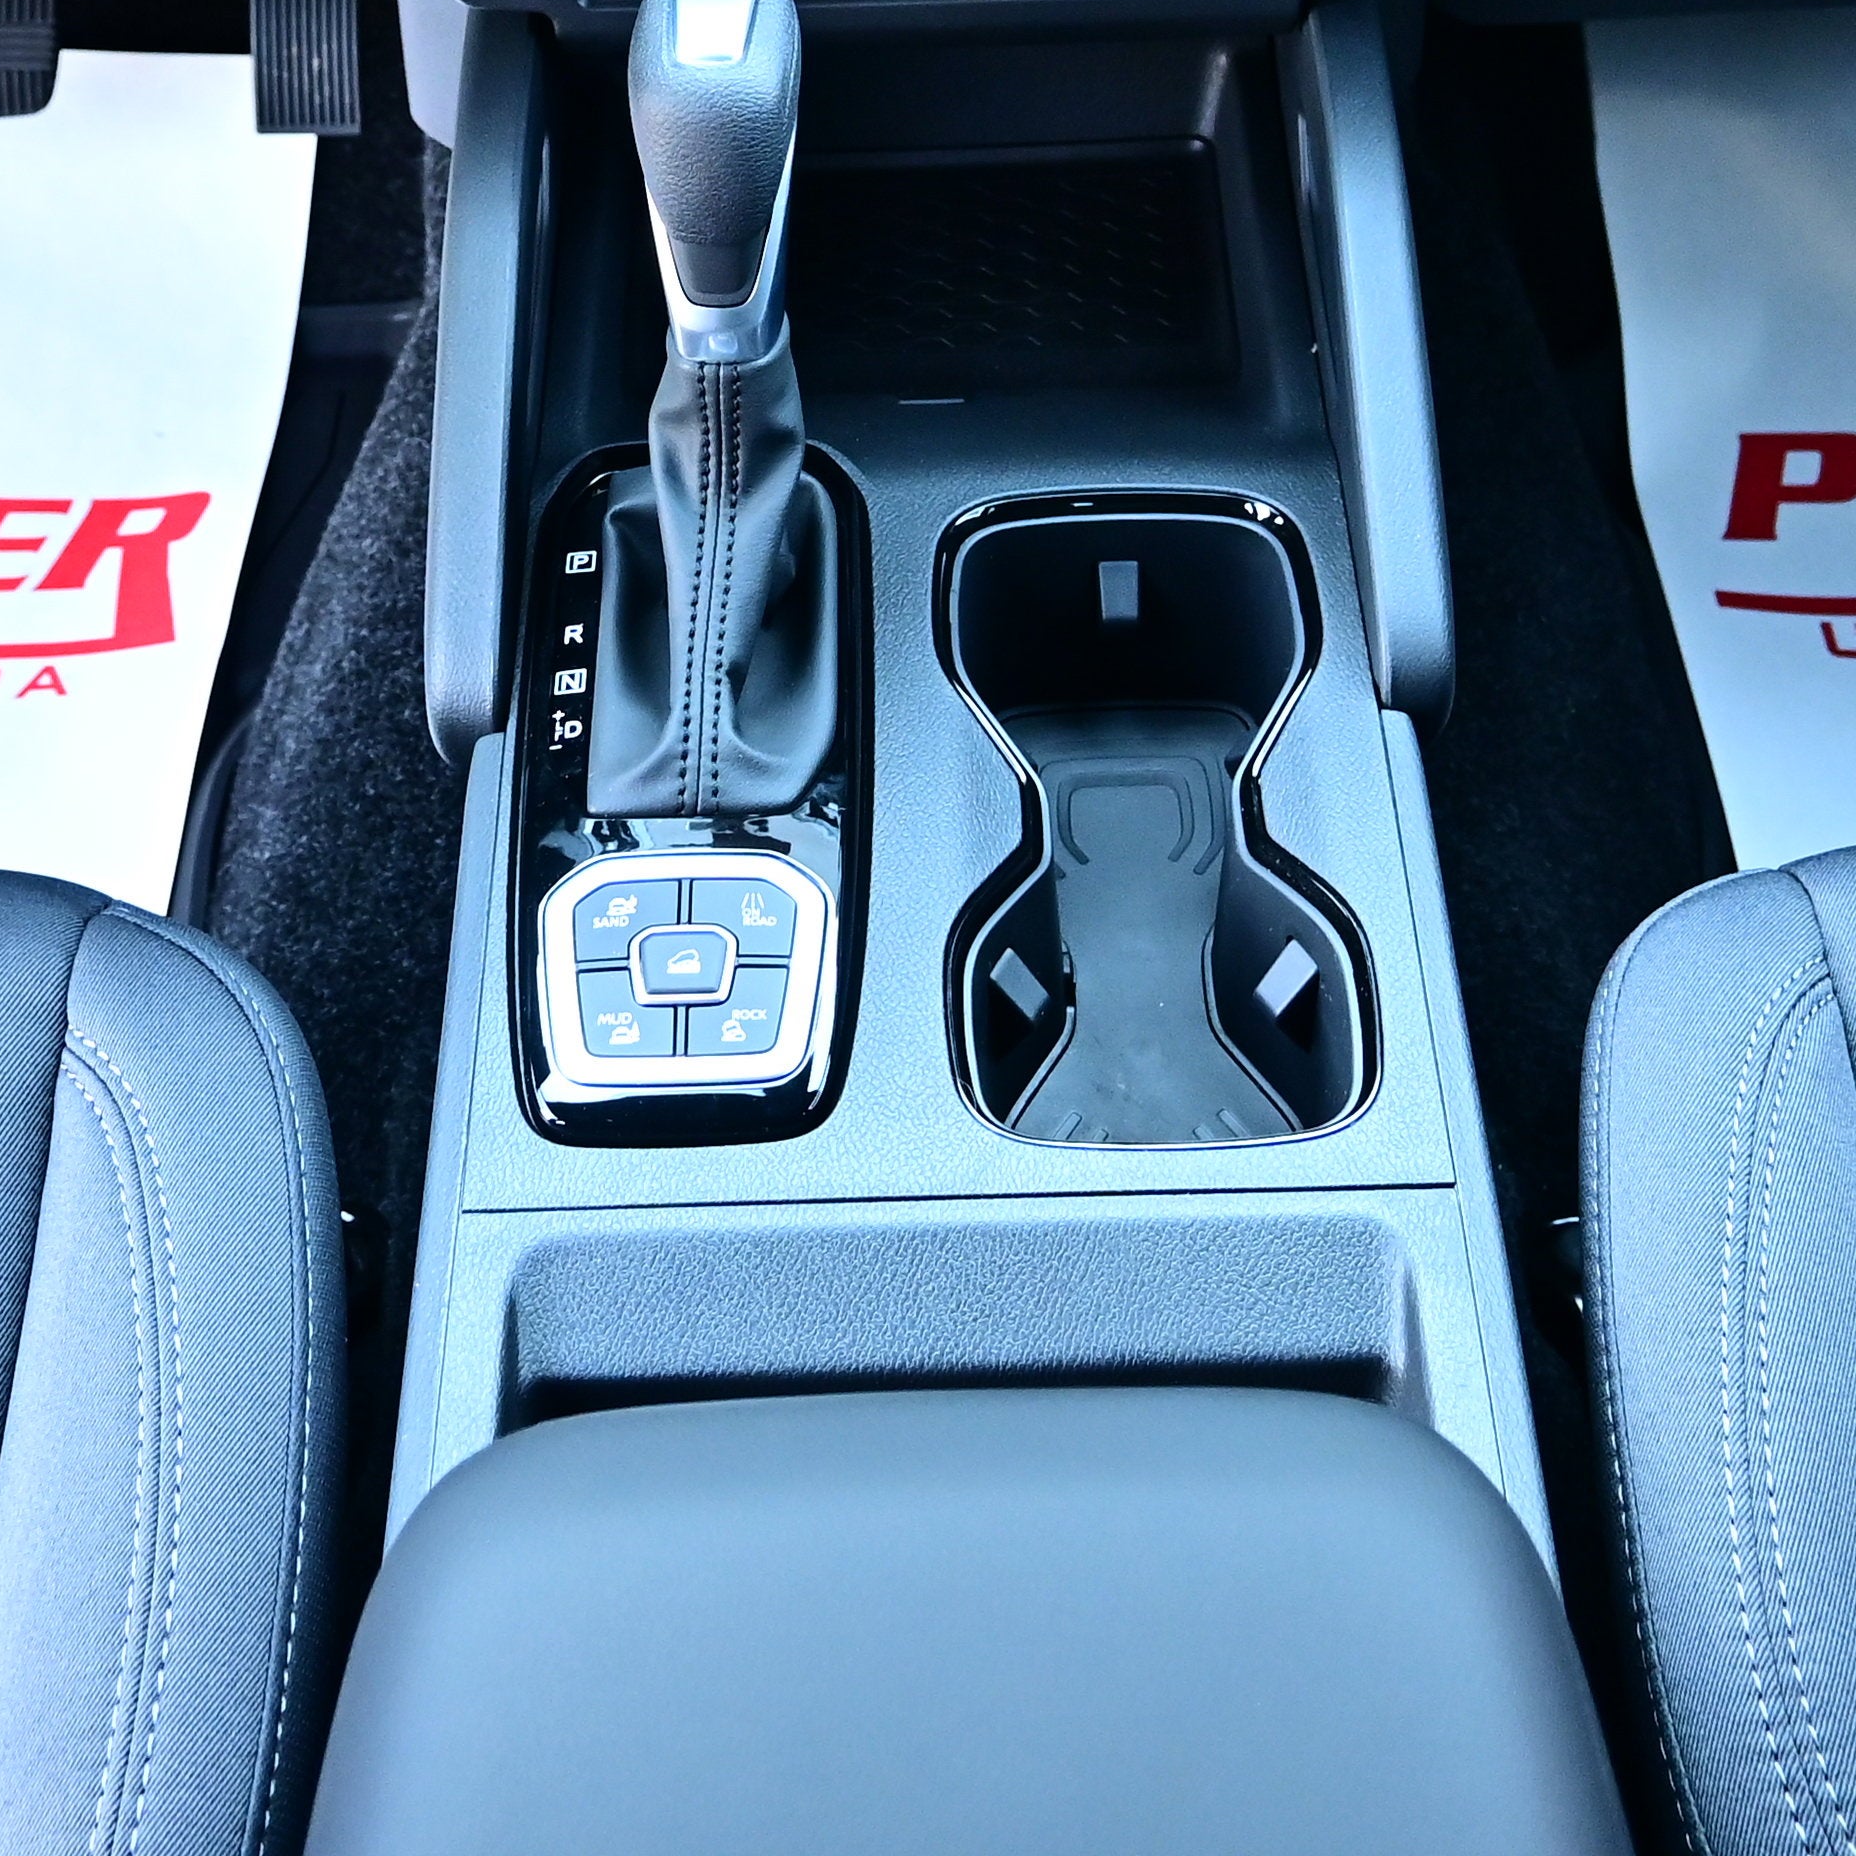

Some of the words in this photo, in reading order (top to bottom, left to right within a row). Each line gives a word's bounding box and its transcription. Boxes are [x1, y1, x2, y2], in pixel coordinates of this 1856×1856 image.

[573, 554, 590, 569] P
[564, 623, 584, 644] R
[560, 673, 581, 691] N
[564, 720, 583, 739] D
[593, 917, 630, 928] SAND
[597, 1013, 633, 1025] MUD
[732, 1008, 768, 1021] ROCK
